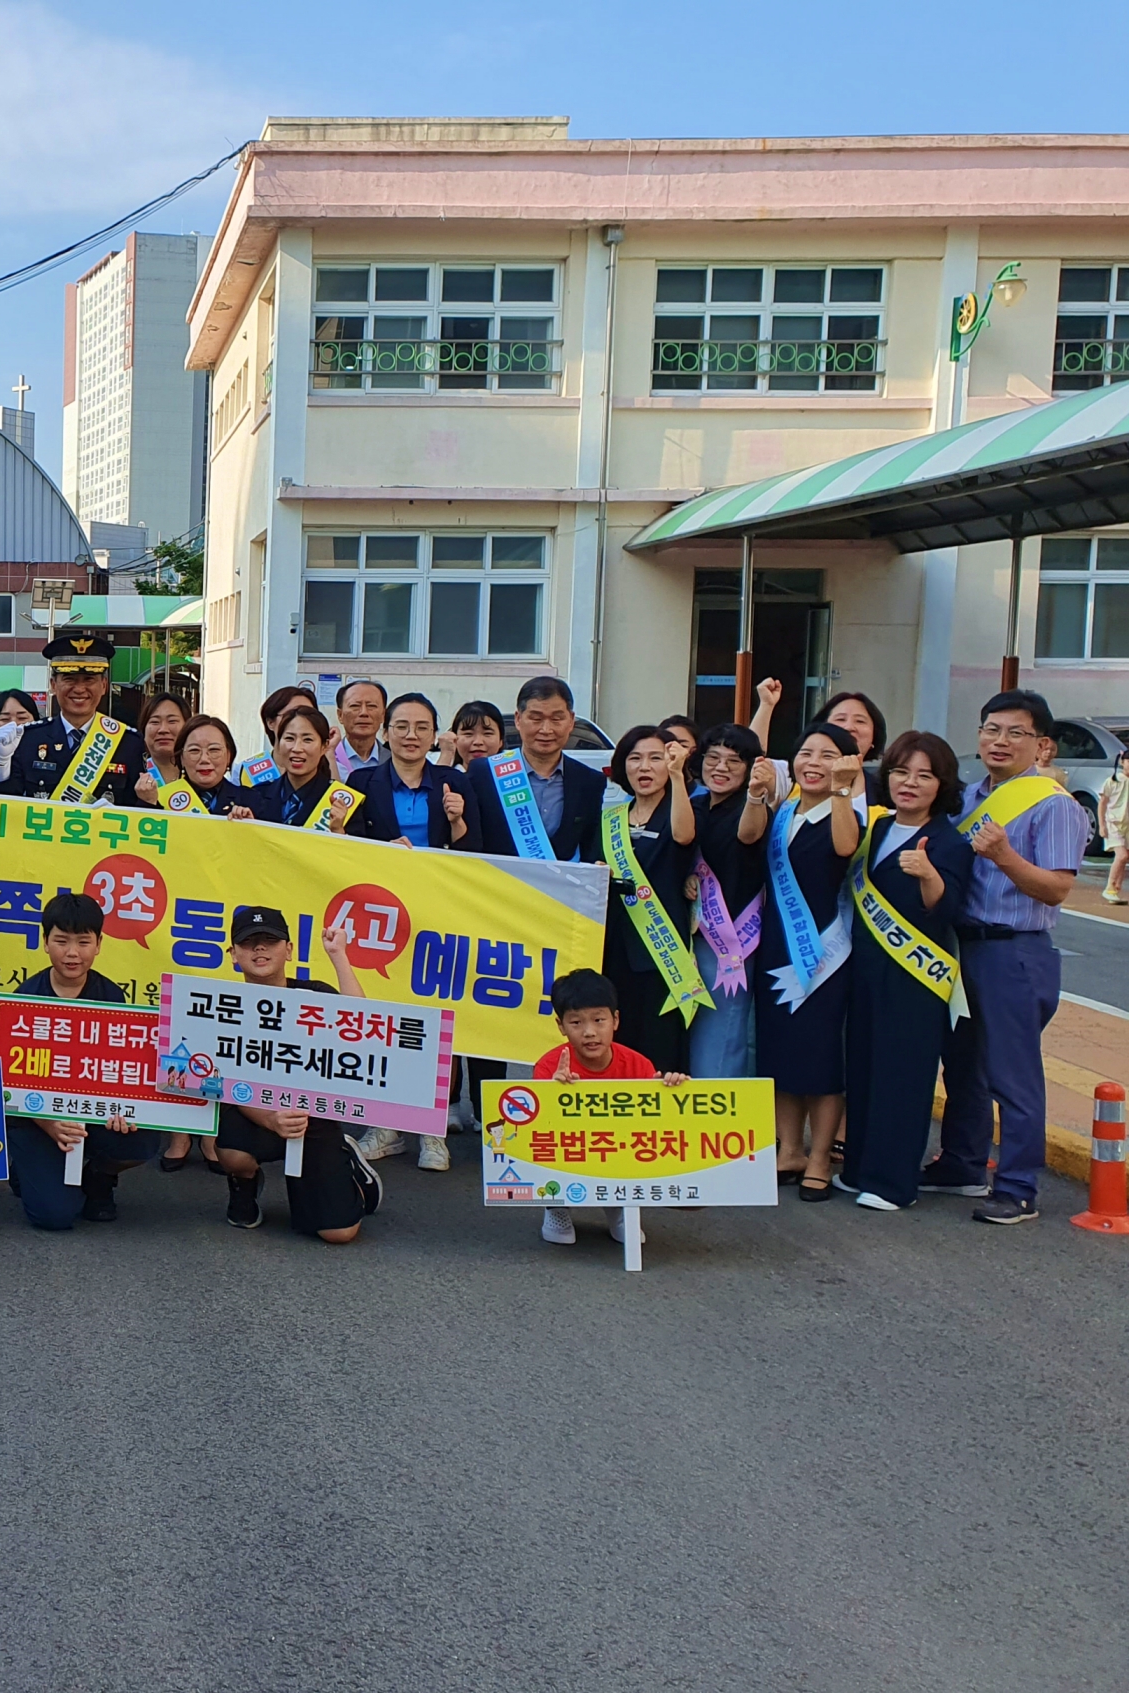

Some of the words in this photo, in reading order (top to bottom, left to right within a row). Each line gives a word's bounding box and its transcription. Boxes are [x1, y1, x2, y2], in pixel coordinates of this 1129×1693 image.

[103, 719, 118, 731] 30
[74, 732, 111, 787] 안전한
[173, 793, 188, 807] 30
[22, 806, 169, 855] 보호구역
[637, 887, 651, 898] 30
[89, 870, 155, 922] 3초
[170, 896, 313, 981] 동!
[331, 900, 400, 951] 4고
[411, 929, 559, 1016] 예방!
[645, 923, 665, 949] 사람이
[659, 949, 684, 984] 보입니다
[658, 925, 679, 951] 줄이면
[186, 991, 245, 1026] 교문
[257, 998, 286, 1031] 앞
[10, 1013, 73, 1044] 스쿨존
[79, 1020, 100, 1045] 내
[8, 1045, 73, 1079] 2배로
[215, 1035, 389, 1088] 피해주세요!!
[51, 1096, 136, 1119] 문선초등학교
[260, 1088, 366, 1119] 문선초등학교
[557, 1091, 662, 1117] 안전운전
[672, 1091, 737, 1117] YES!
[700, 1129, 756, 1162] NO!
[595, 1184, 701, 1201] 문선초등학교
